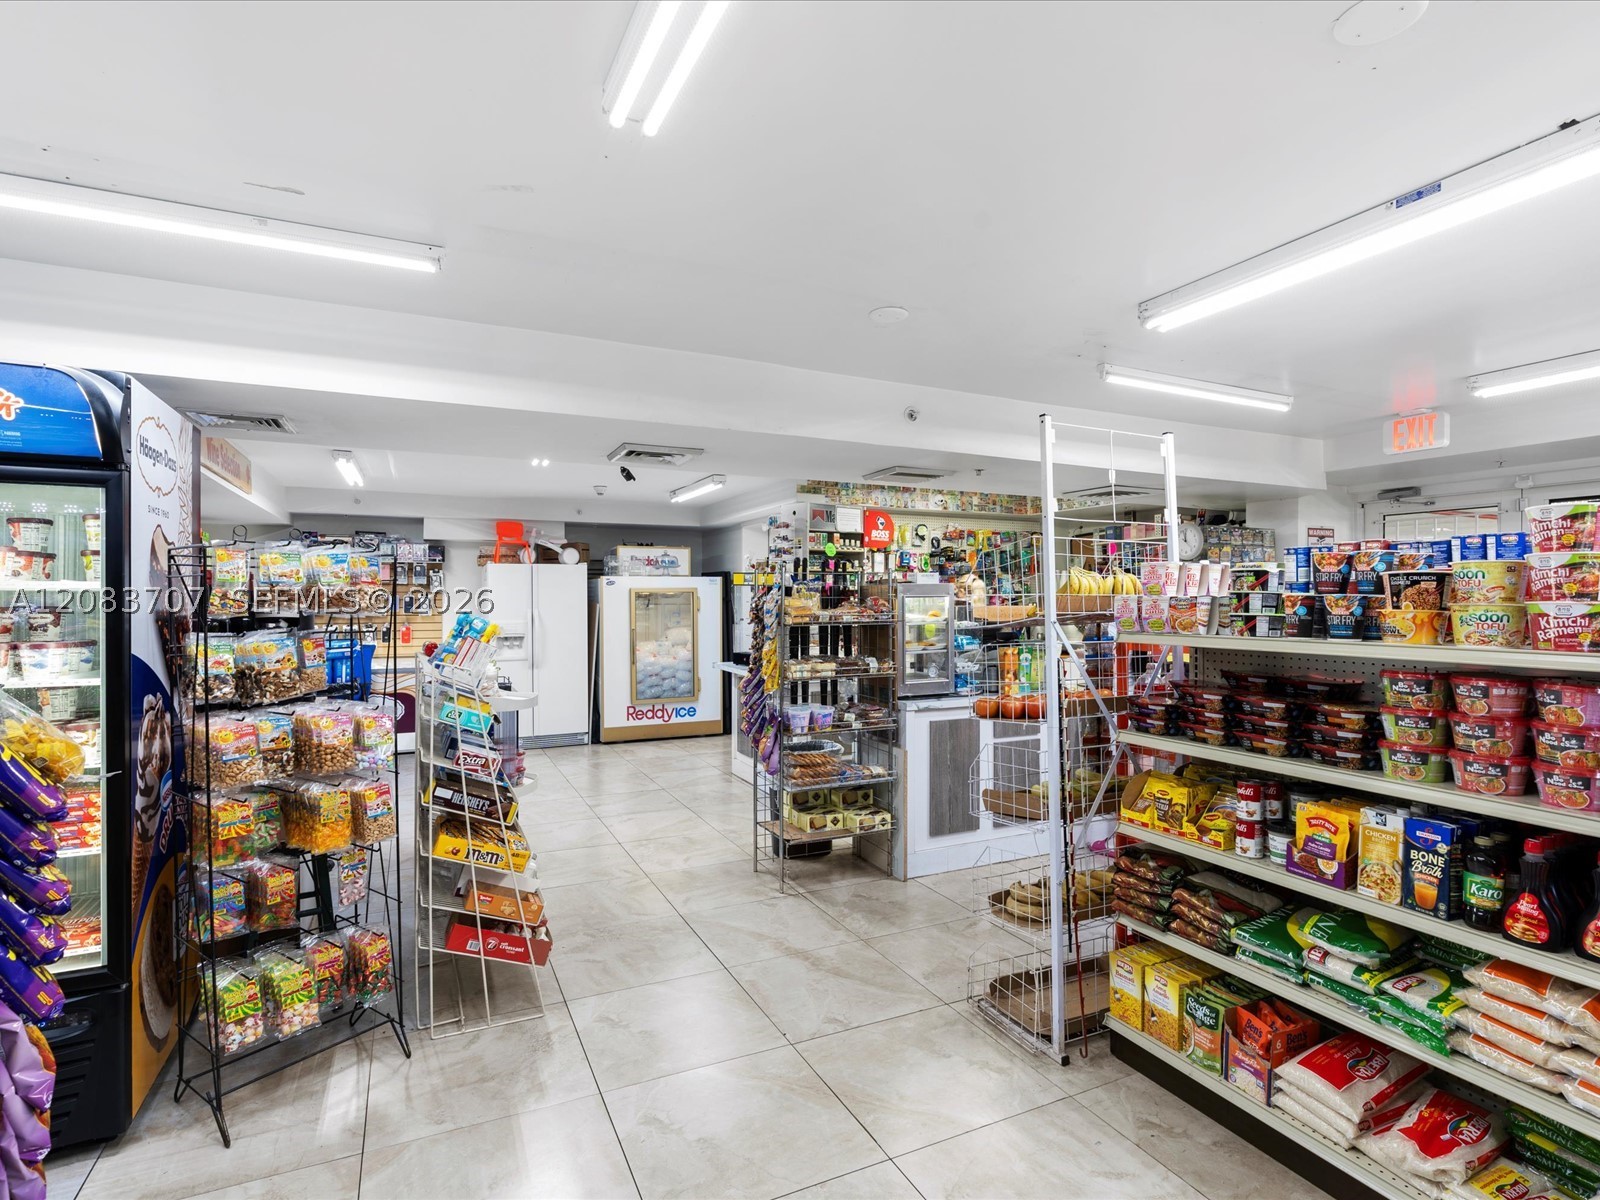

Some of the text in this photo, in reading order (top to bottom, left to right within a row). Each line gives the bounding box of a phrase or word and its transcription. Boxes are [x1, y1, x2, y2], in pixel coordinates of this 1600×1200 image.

[1393, 413, 1437, 451] EXIT
[825, 510, 836, 523] Ma
[1530, 519, 1571, 534] Kimchi
[871, 529, 890, 538] BOSS
[1315, 573, 1343, 582] STIR FRY
[1363, 571, 1378, 581] FRY
[1530, 567, 1570, 581] Kimchi
[1457, 579, 1482, 588] TOFU
[1327, 616, 1356, 625] STIR FRY
[1474, 622, 1506, 631] TOFU
[1538, 616, 1589, 629] Kimchi
[1536, 626, 1582, 642] Ramen
[1365, 829, 1397, 842] CHICKEN
[1417, 832, 1440, 840] SWANSON
[1410, 849, 1446, 867] BONE
[1411, 860, 1443, 879] Broth
[1470, 883, 1503, 900] Karo
[1516, 904, 1540, 917] Milling
[1519, 899, 1538, 910] Pearl
[1514, 913, 1538, 925] Original
[499, 945, 525, 953] croissant
[1187, 997, 1210, 1015] Seeds
[1186, 1003, 1216, 1026] Change
[1245, 1018, 1263, 1038] Ben's
[1275, 1039, 1281, 1049] 6
[1354, 1053, 1388, 1079] IBERIA
[1458, 1116, 1489, 1144] IBERIA
[1501, 1183, 1529, 1200] IBERIA
